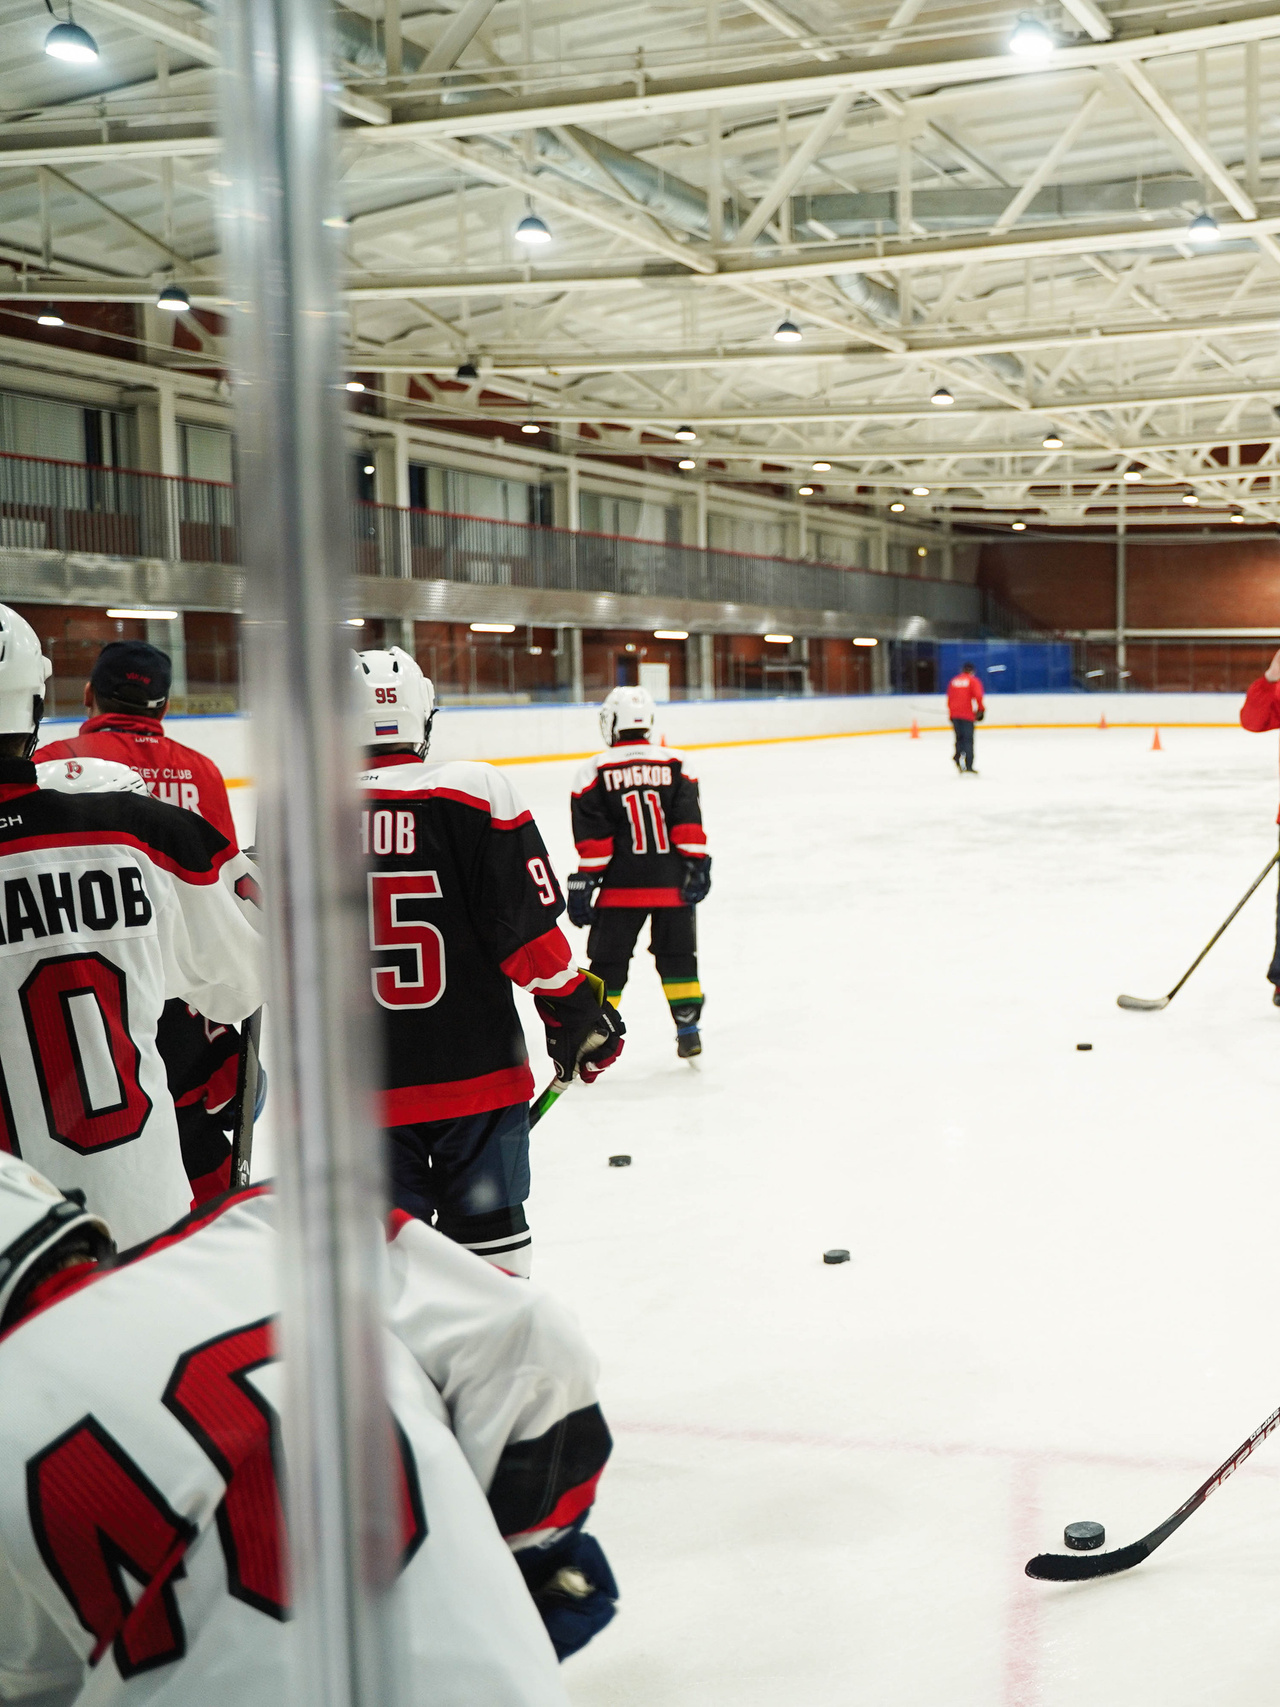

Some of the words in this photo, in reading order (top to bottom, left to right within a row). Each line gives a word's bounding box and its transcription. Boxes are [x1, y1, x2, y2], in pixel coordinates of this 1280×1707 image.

[375, 688, 397, 704] 95
[163, 769, 192, 780] CLUB
[603, 765, 672, 792] ГРИБКОВ
[622, 790, 671, 854] 11
[526, 855, 562, 906] 9
[0, 867, 153, 945] АНОВ
